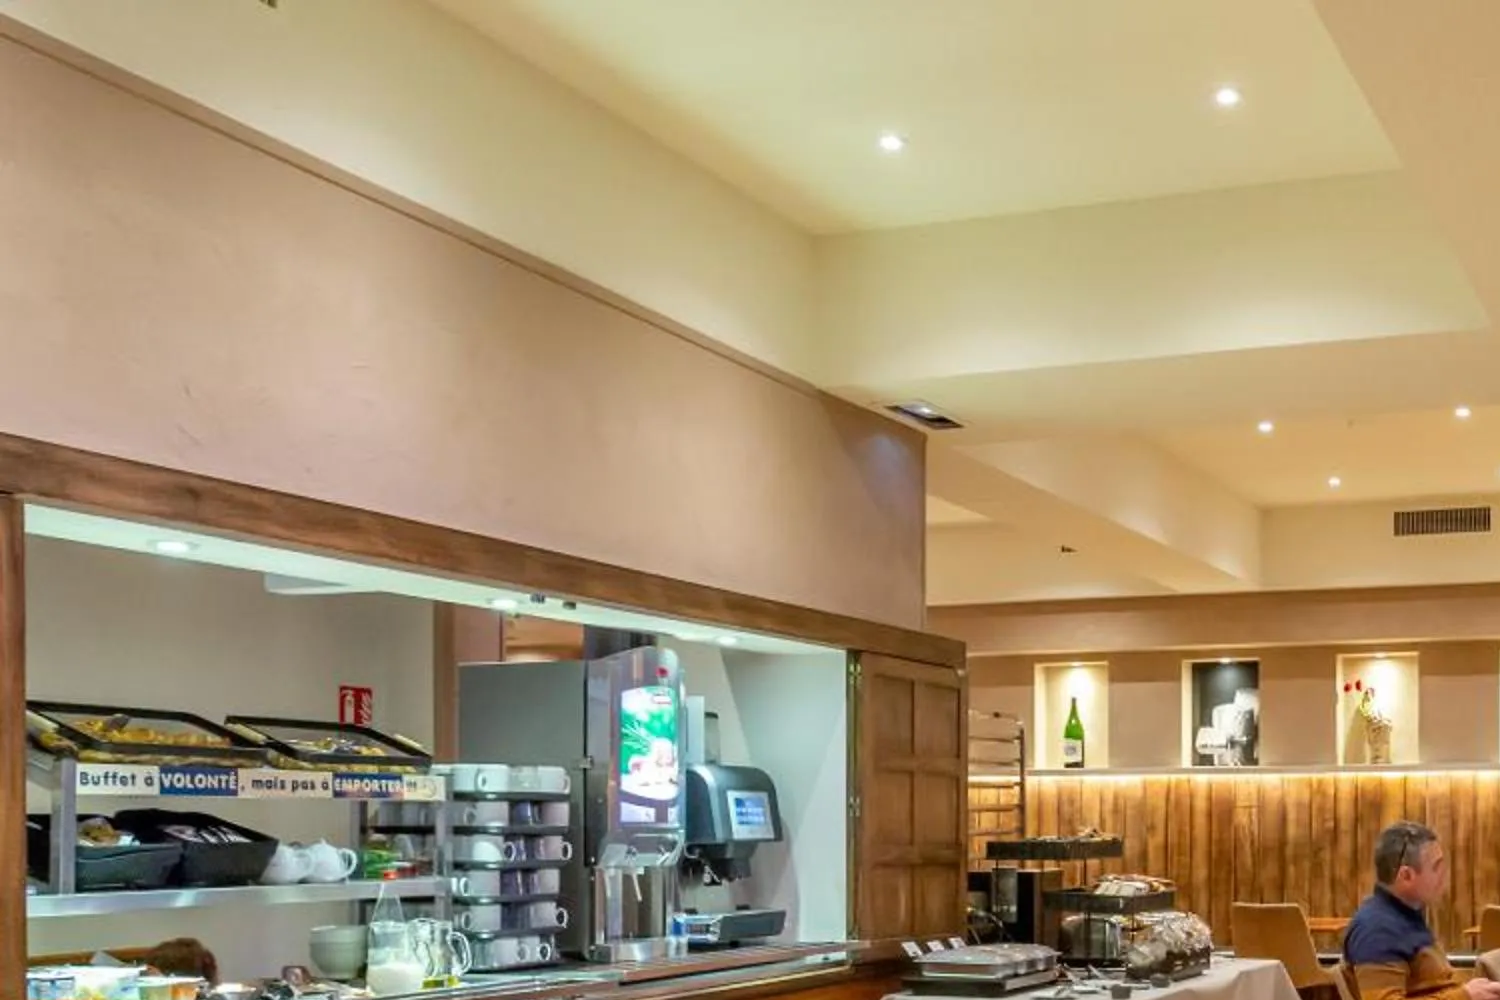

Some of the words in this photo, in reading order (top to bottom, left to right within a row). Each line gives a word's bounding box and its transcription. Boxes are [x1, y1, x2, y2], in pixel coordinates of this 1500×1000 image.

[78, 770, 136, 786] Buffet
[251, 776, 286, 789] mais
[291, 778, 316, 792] pas
